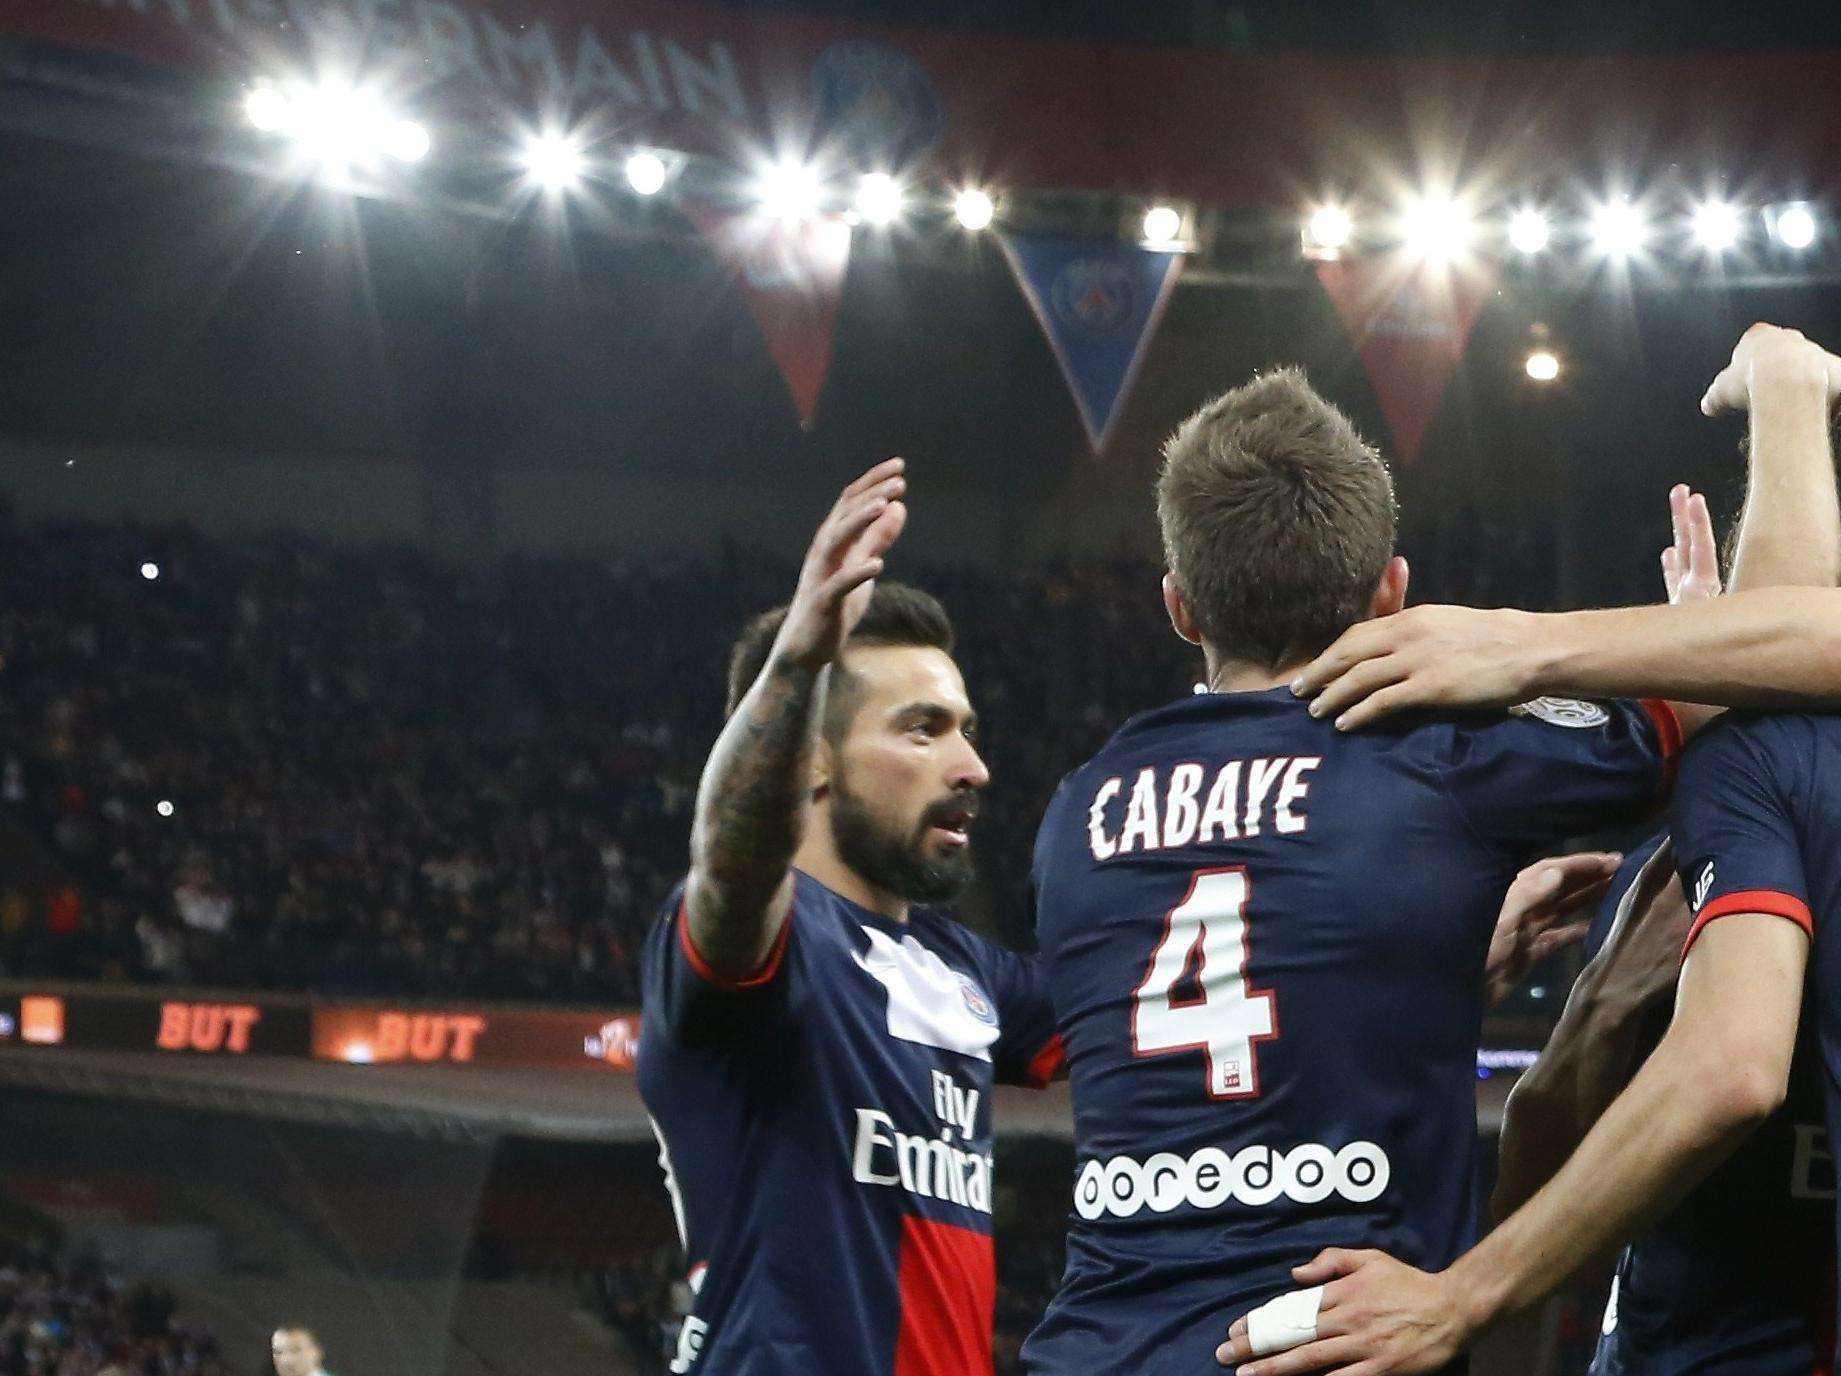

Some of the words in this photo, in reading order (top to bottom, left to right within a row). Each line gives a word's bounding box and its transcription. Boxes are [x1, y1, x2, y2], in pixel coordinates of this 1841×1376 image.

[1088, 755, 1322, 860] CABAYE
[1131, 865, 1279, 1100] 4
[156, 1002, 261, 1053] BUT
[372, 1012, 485, 1062] BUT
[931, 1069, 979, 1141] Fly
[852, 1108, 994, 1216] Emirat
[1073, 1141, 1391, 1220] ooredoo
